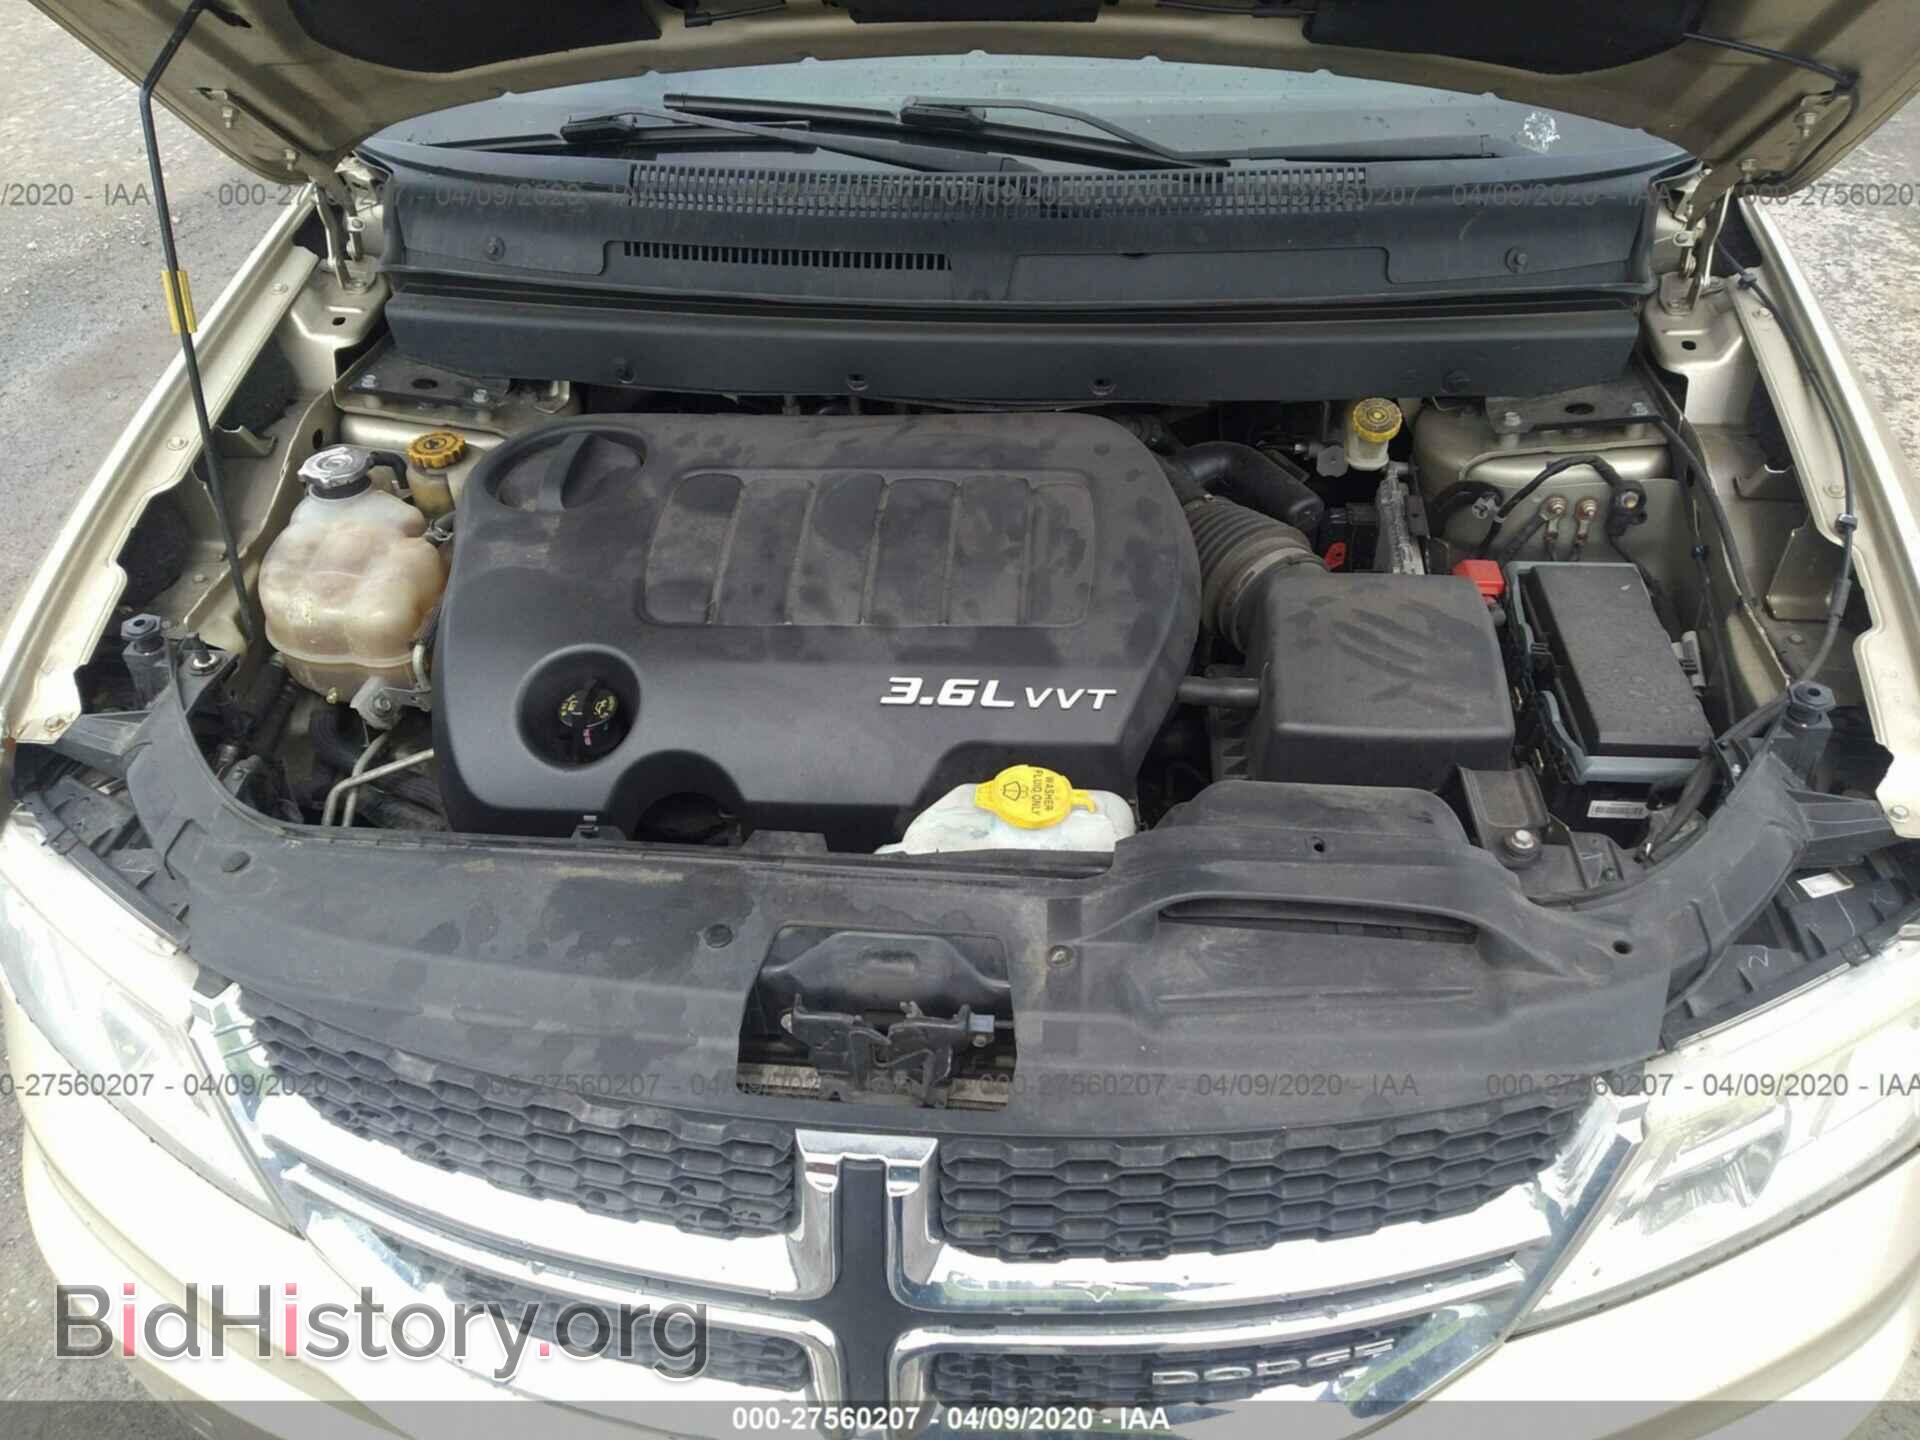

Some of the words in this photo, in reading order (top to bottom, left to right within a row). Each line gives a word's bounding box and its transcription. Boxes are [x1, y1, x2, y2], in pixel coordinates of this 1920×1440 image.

[879, 676, 1015, 708] 3.6L
[1024, 687, 1117, 710] VVT
[1031, 769, 1043, 793] FLUID
[1044, 776, 1055, 812] WASHER
[1031, 794, 1042, 816] ONLY
[1152, 1337, 1395, 1385] DODGE
